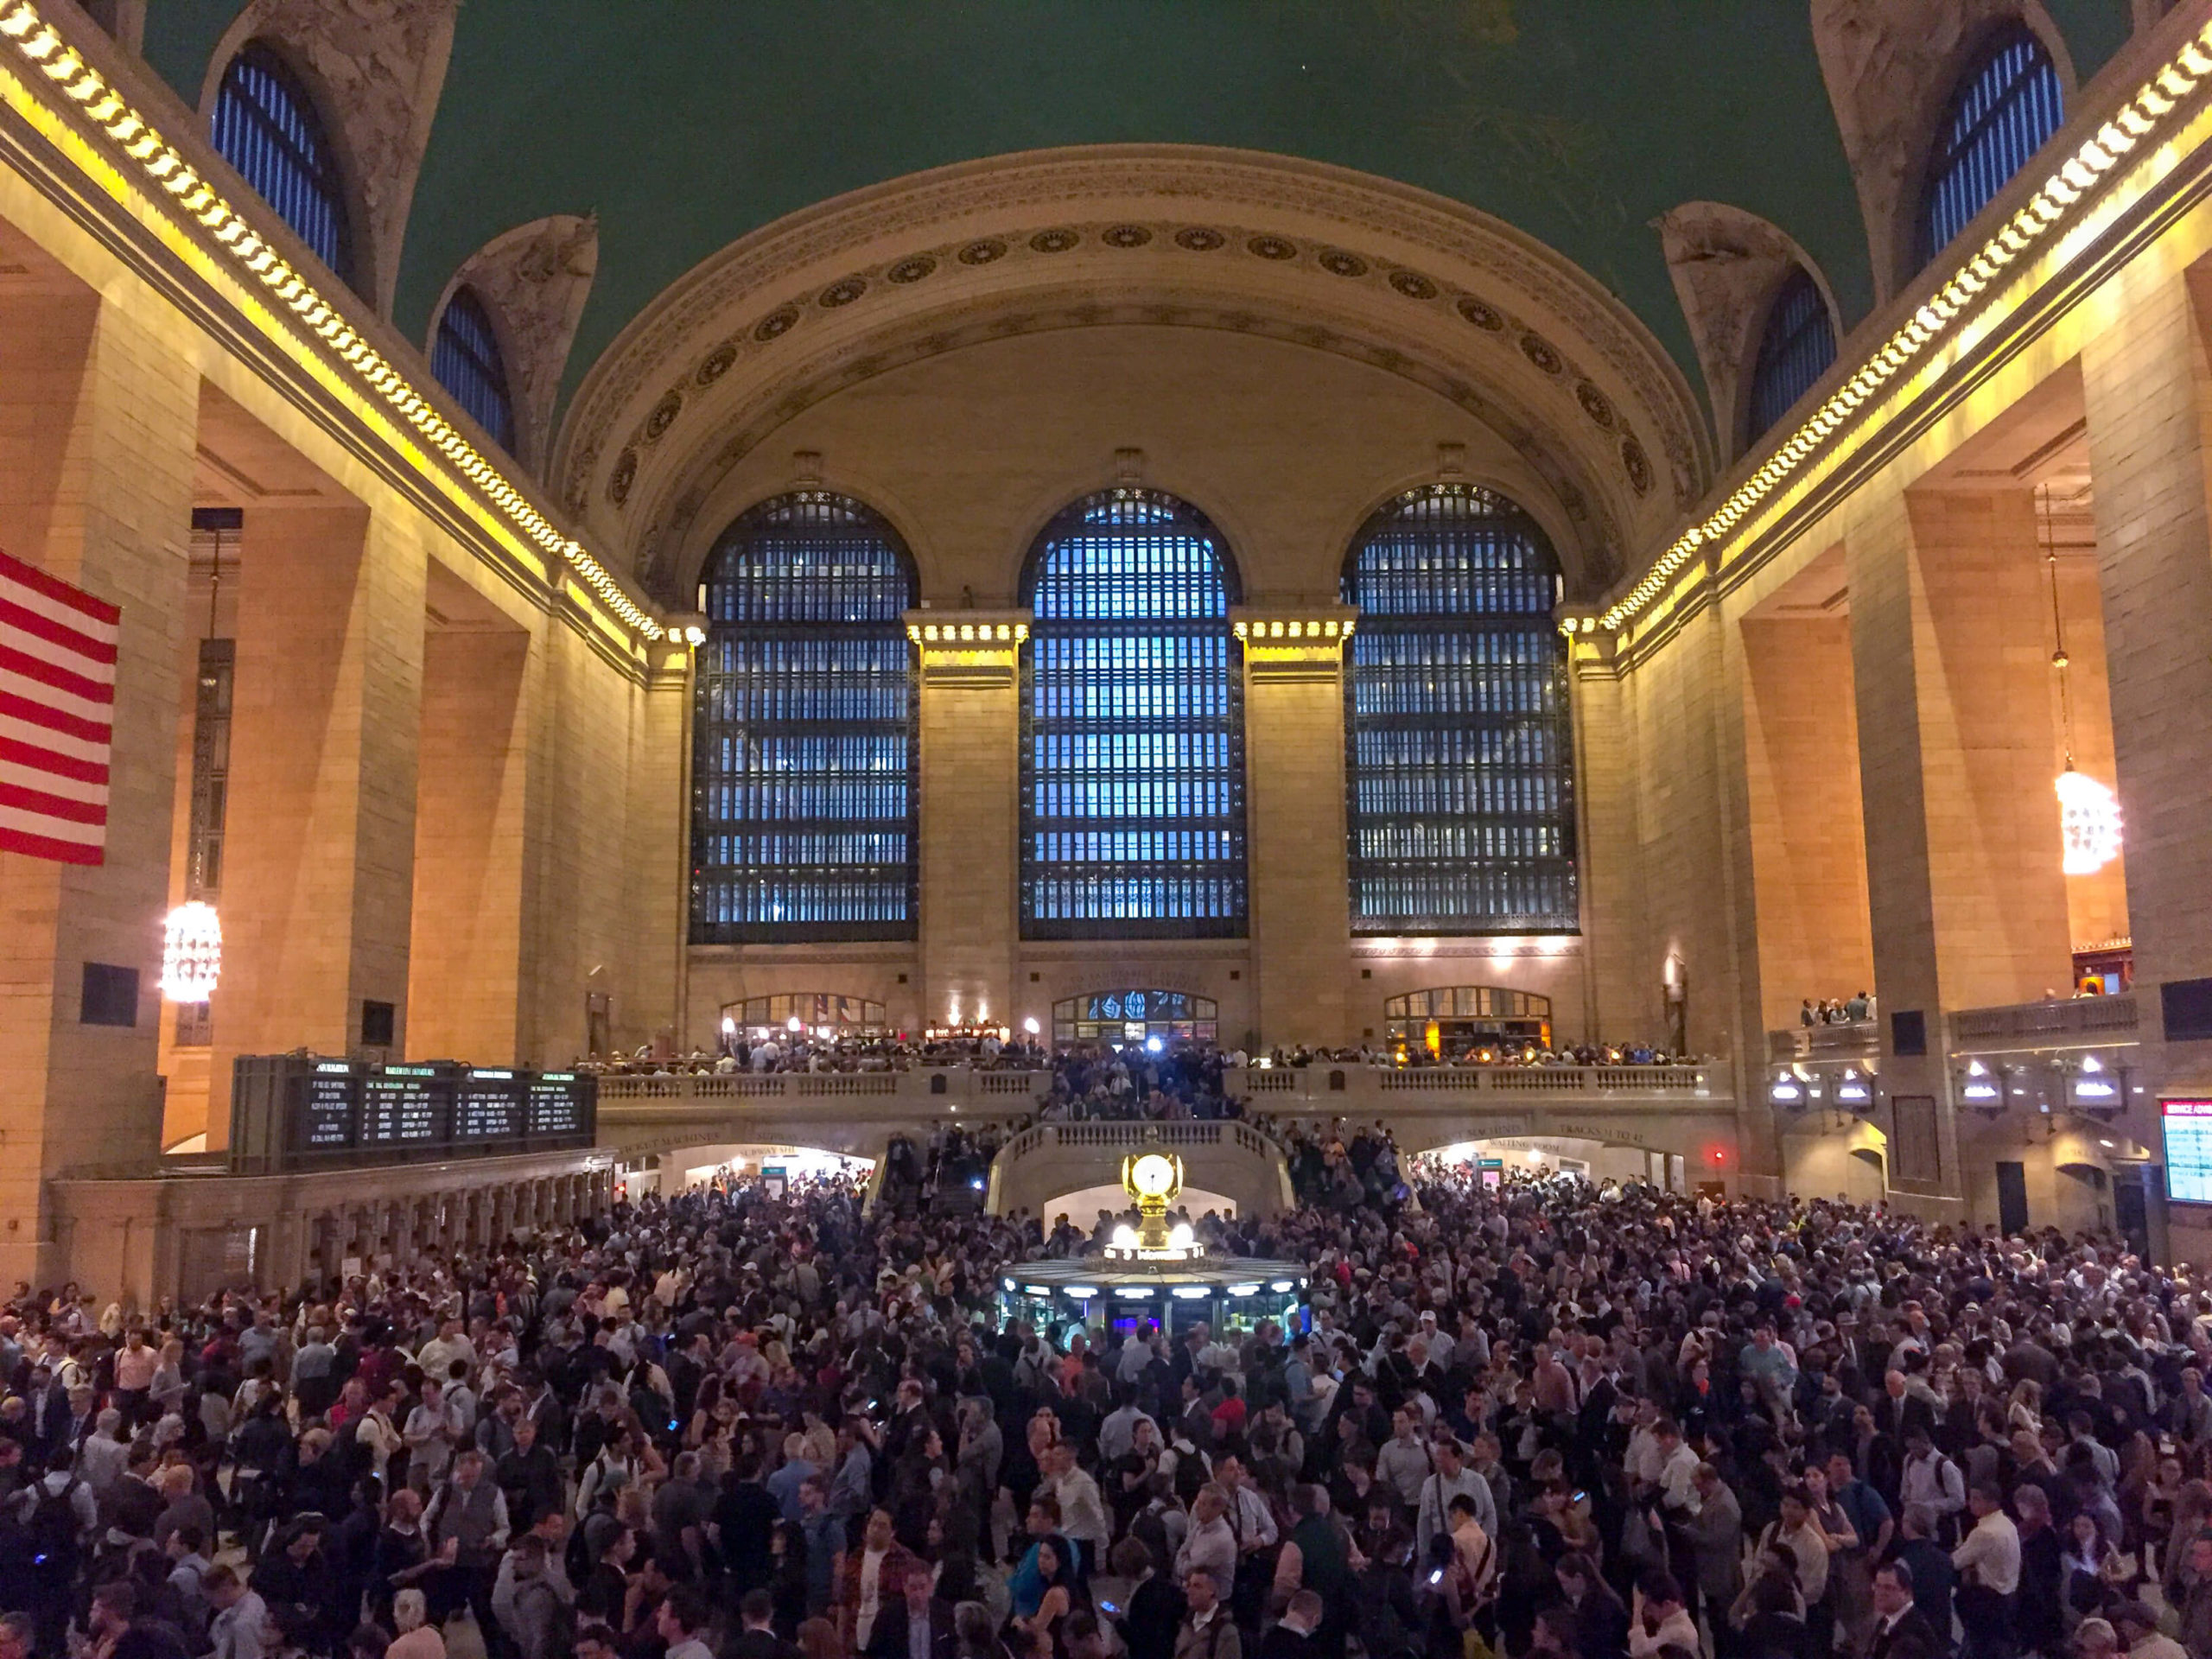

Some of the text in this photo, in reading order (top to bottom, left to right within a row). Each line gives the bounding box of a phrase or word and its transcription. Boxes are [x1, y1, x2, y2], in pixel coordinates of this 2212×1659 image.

[2167, 1104, 2193, 1114] SERVICE
[1559, 1124, 1600, 1135] TRACKS
[1488, 1137, 1529, 1148] WAITING
